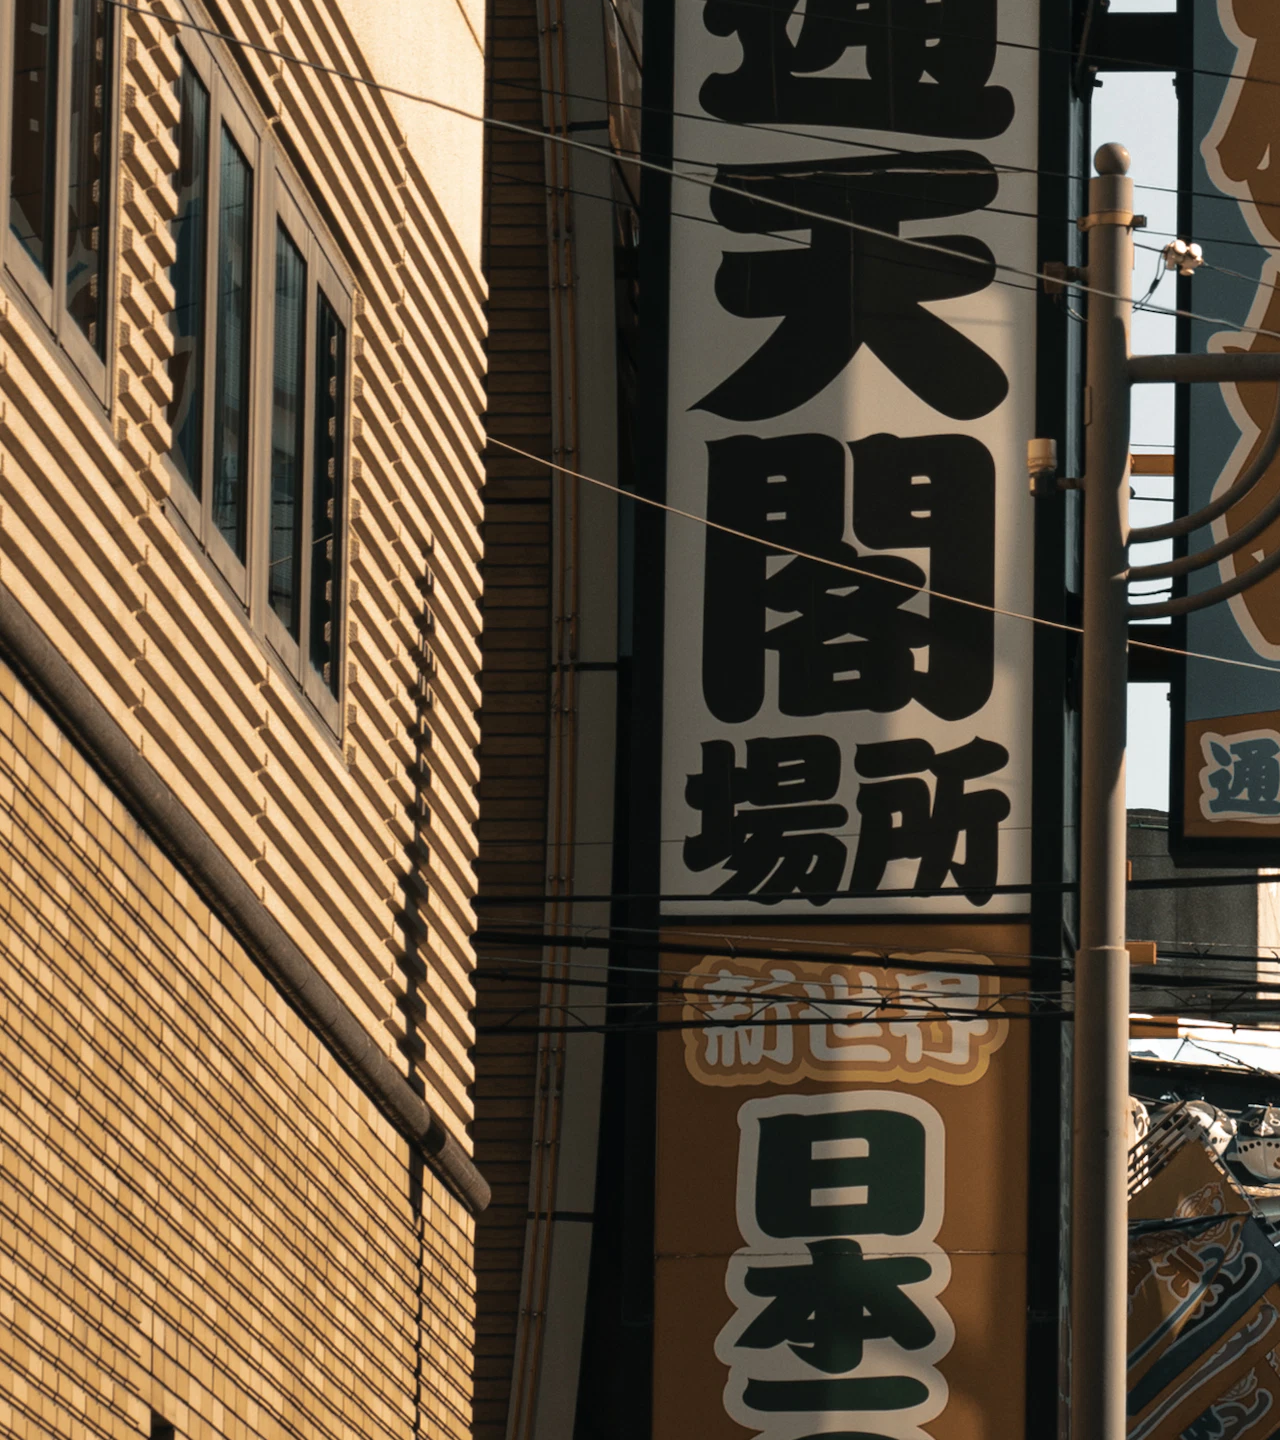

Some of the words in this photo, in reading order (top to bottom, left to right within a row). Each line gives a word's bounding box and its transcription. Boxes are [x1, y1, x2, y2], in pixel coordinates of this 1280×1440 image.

[682, 734, 1010, 907] 場所
[698, 963, 990, 1067] 新世界
